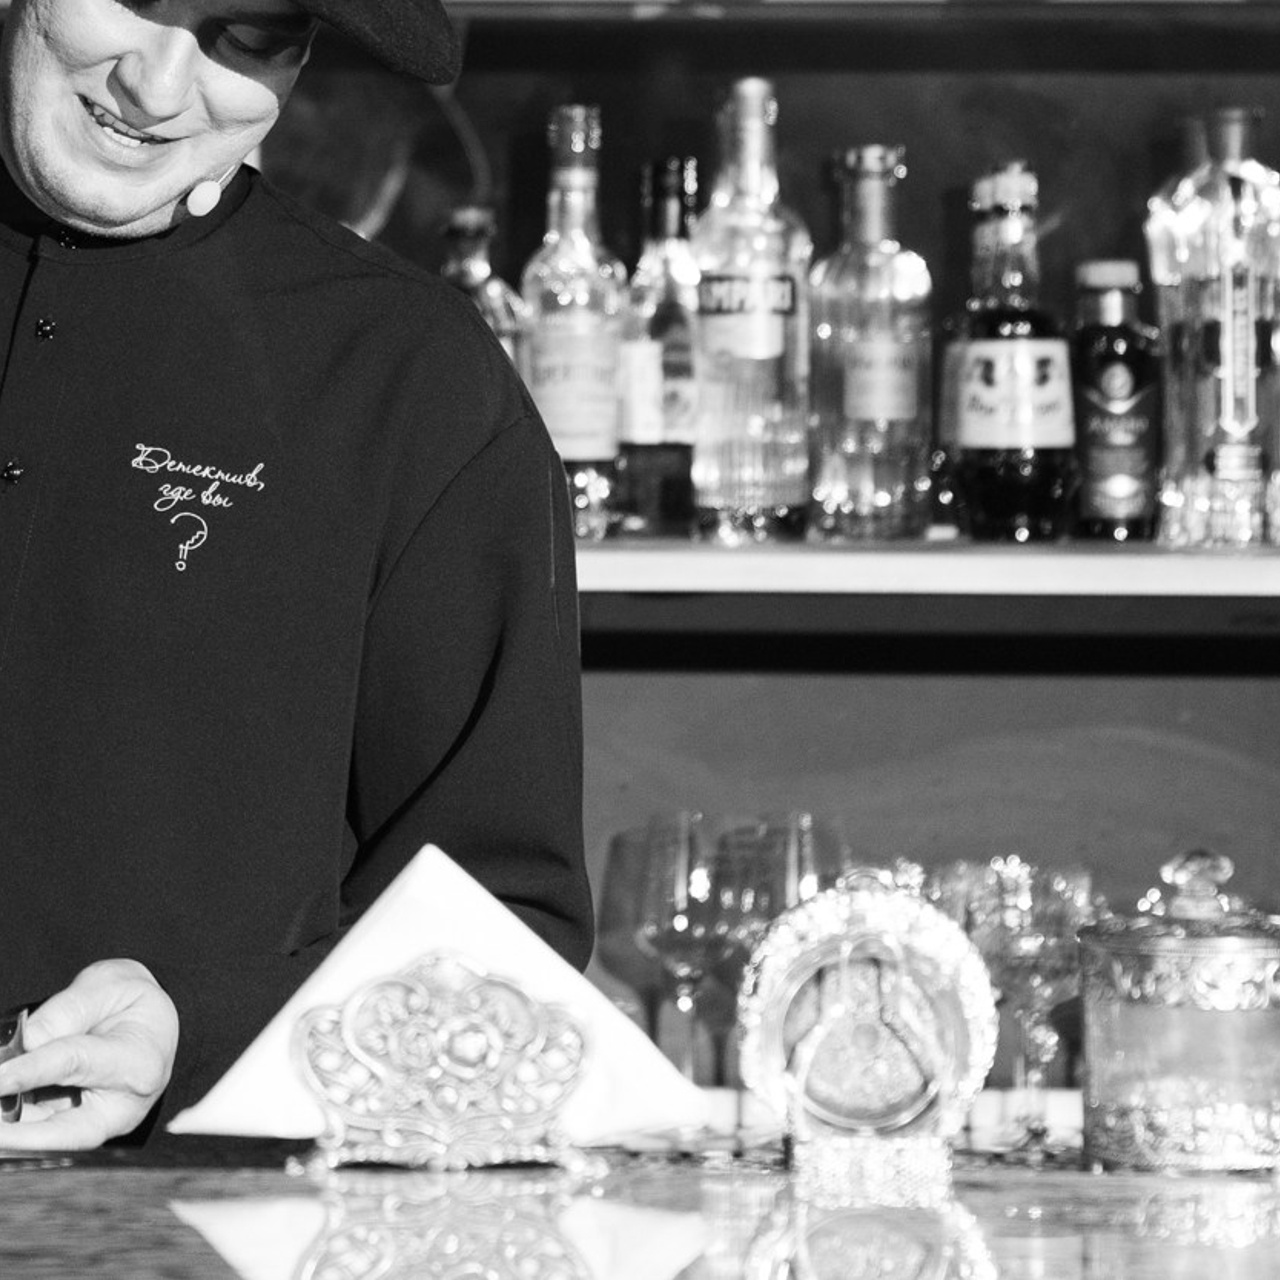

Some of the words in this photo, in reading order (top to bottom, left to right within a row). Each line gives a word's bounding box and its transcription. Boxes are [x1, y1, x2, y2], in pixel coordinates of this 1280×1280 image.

[131, 443, 265, 491] Детектив,
[153, 483, 196, 512] где
[200, 481, 234, 508] вы
